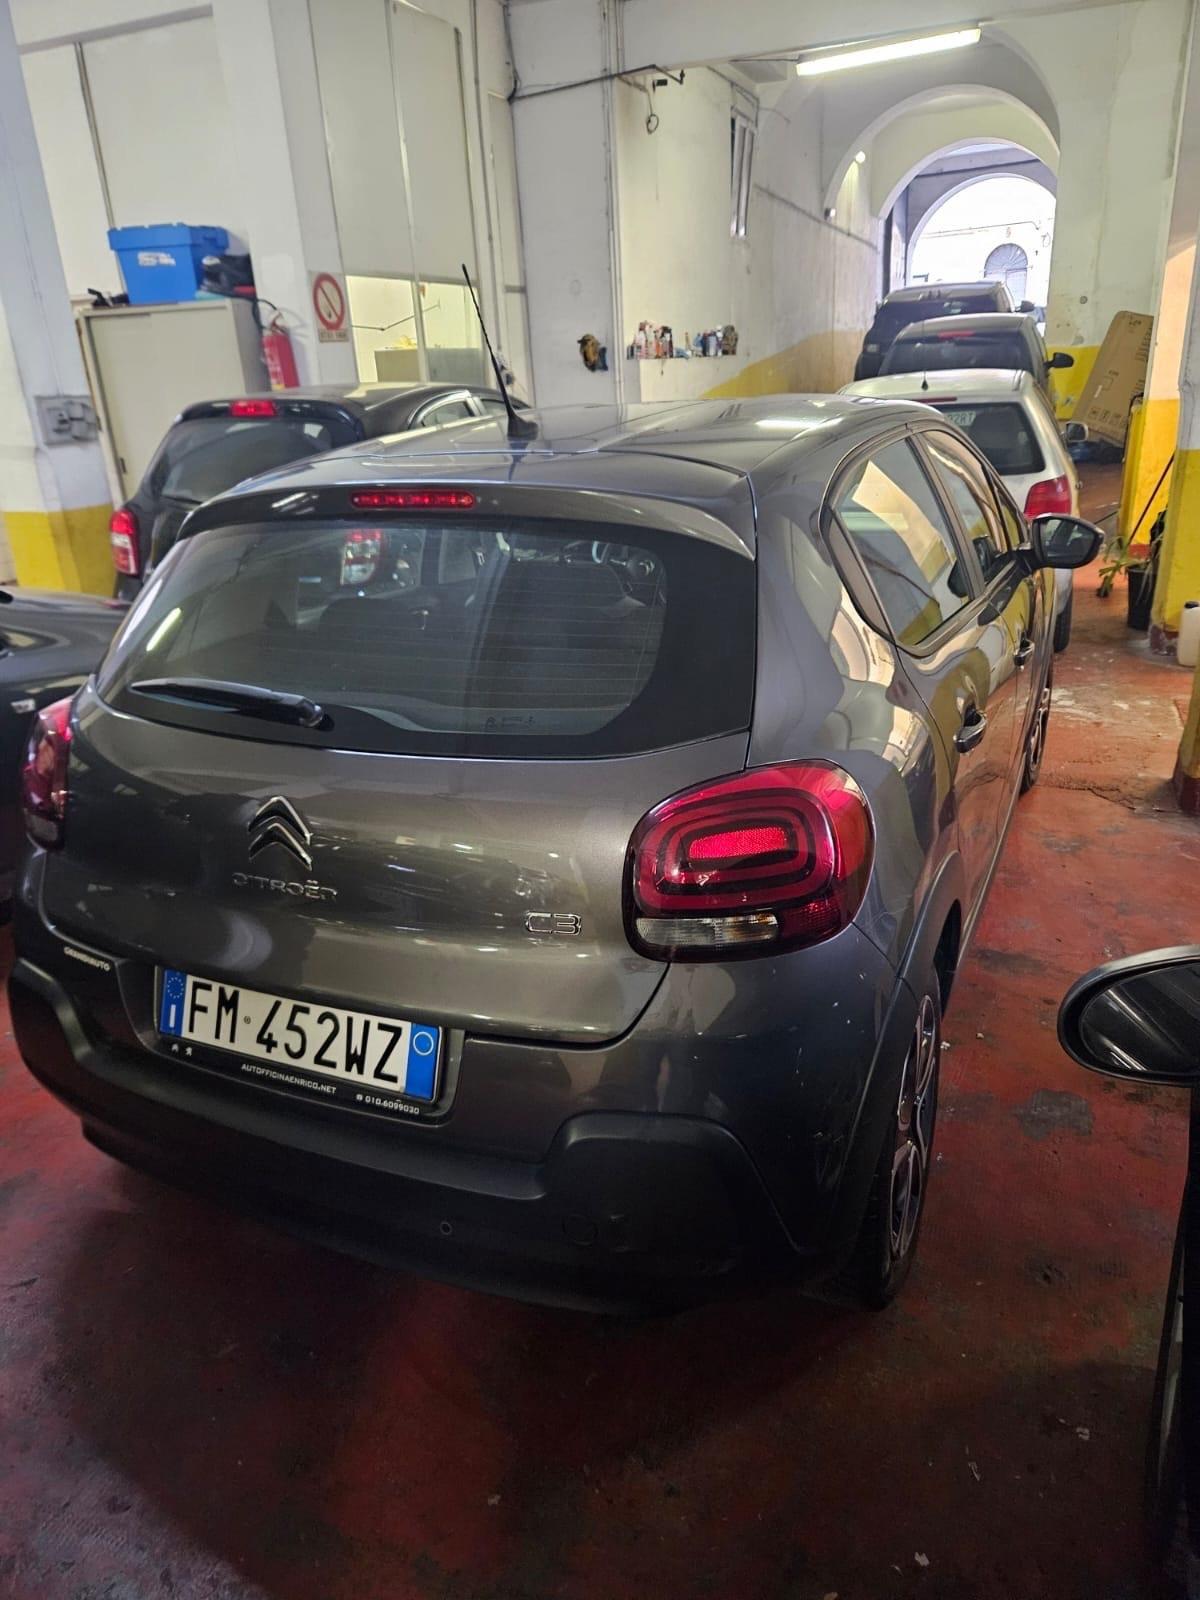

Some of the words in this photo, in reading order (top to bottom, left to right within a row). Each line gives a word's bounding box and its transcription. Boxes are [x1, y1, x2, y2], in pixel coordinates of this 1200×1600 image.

[525, 911, 582, 936] C3
[188, 981, 240, 1044] FM
[256, 1000, 403, 1084] 452WZ
[241, 1063, 337, 1094] AUTOFFICINAENRICO.NET
